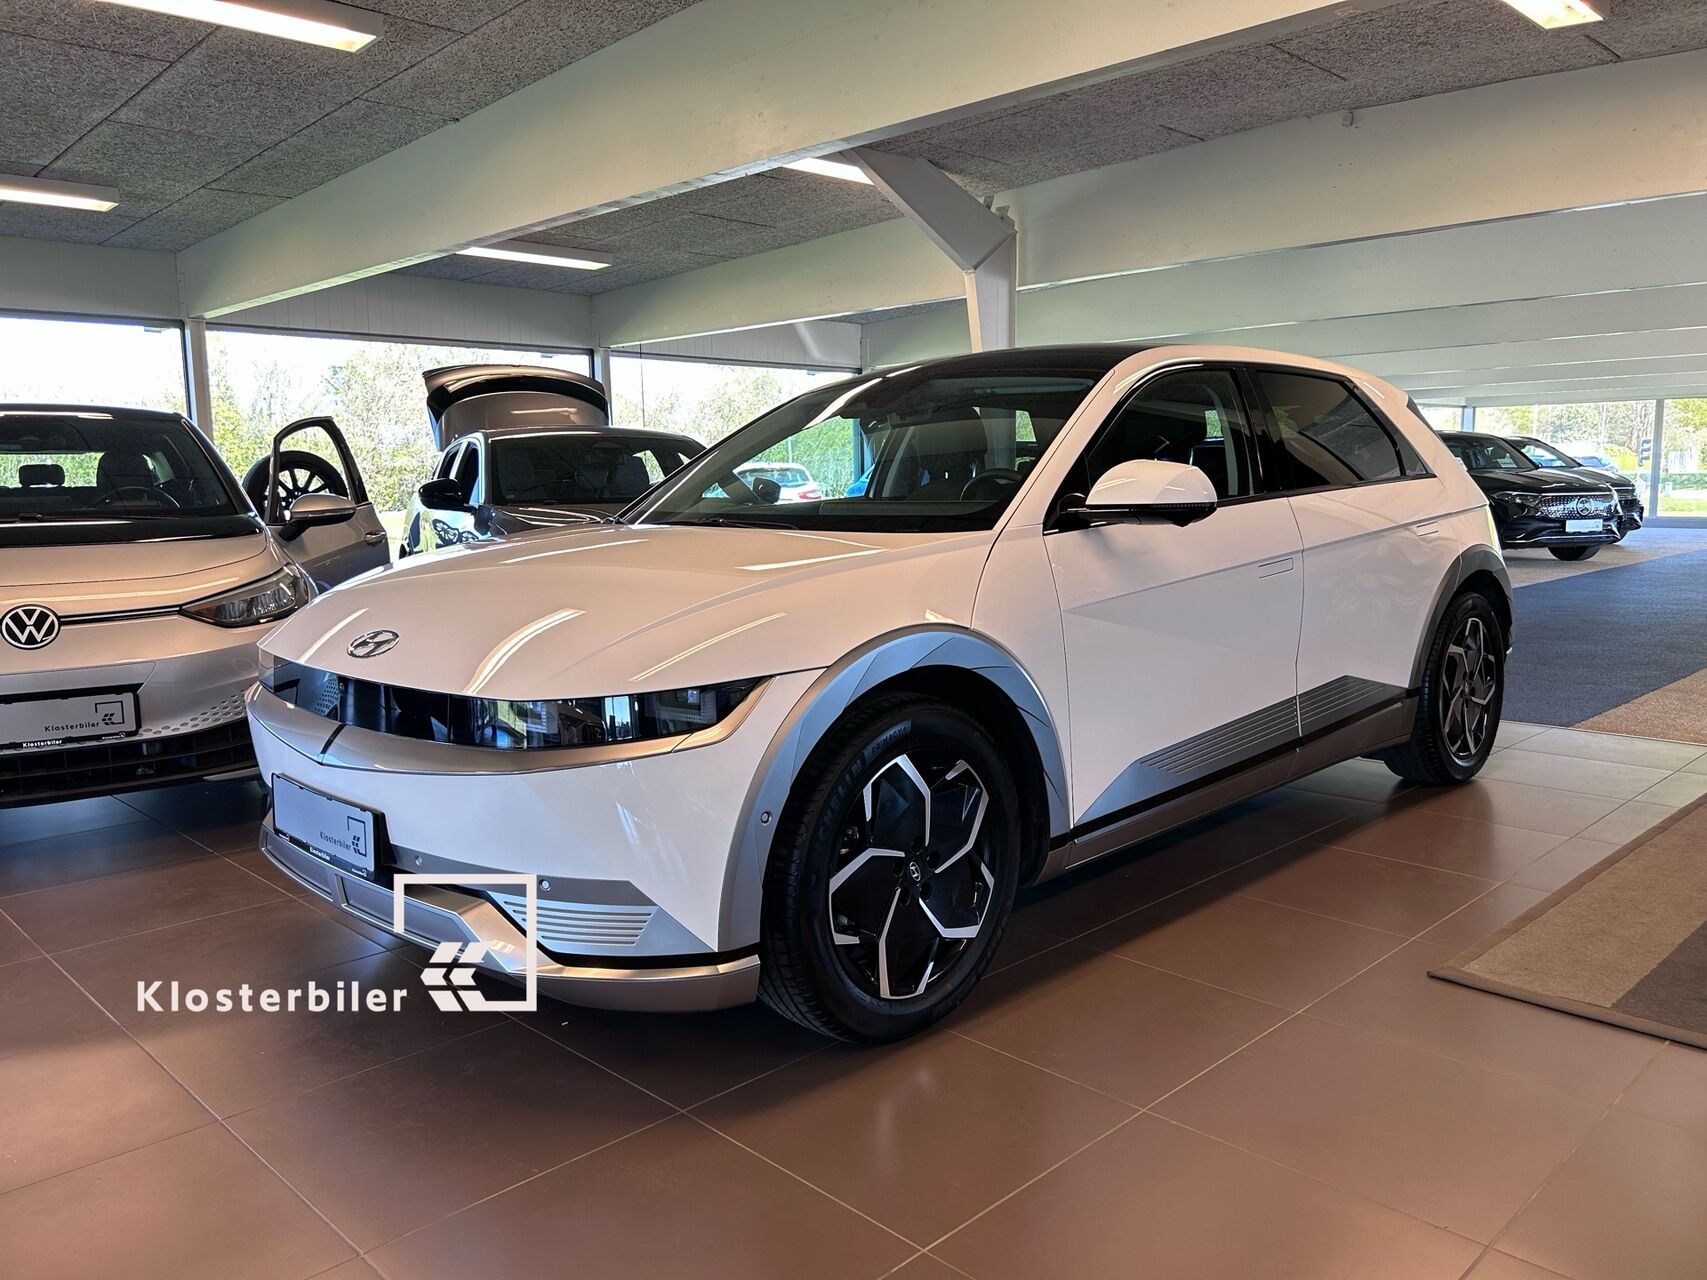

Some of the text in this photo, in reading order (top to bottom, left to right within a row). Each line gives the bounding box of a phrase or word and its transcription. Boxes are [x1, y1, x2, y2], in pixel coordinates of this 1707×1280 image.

[44, 721, 100, 732] Klosterbiler
[22, 739, 63, 748] Klosterbiler
[320, 831, 351, 850] Klosterbiler
